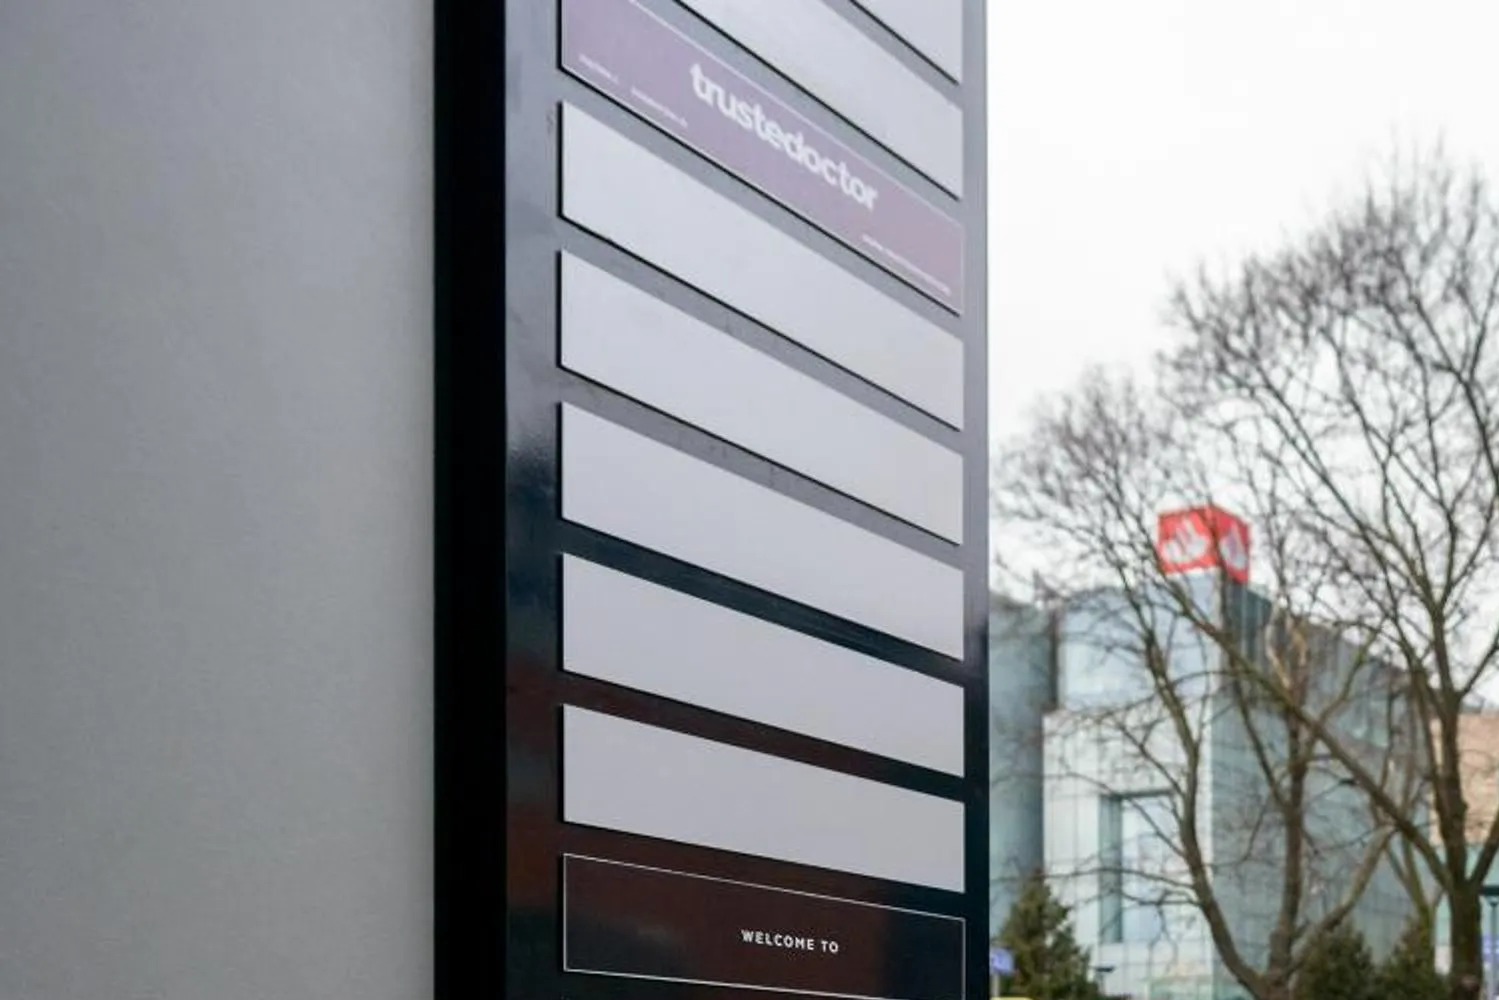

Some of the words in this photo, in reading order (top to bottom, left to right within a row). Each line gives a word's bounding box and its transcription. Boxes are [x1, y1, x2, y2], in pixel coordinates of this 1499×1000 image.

[690, 64, 878, 211] trustedoctor
[741, 929, 815, 951] WELCOME
[821, 940, 839, 953] TO
